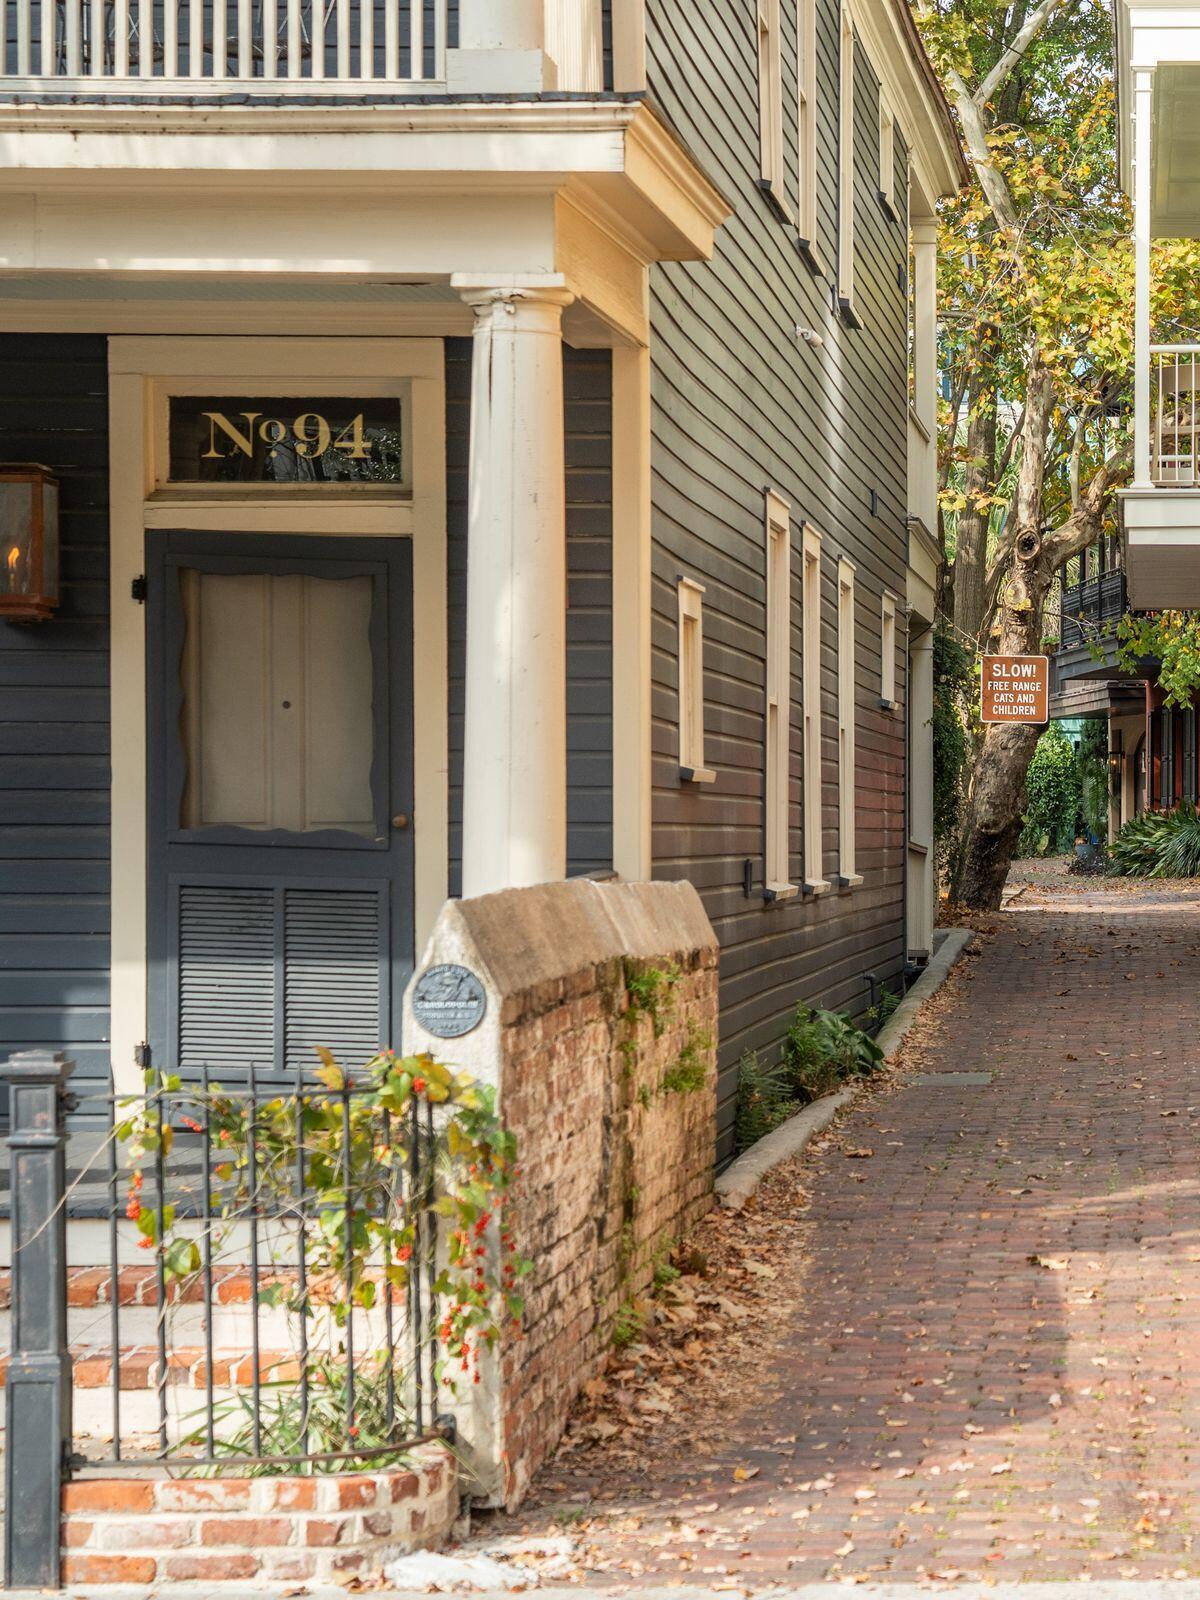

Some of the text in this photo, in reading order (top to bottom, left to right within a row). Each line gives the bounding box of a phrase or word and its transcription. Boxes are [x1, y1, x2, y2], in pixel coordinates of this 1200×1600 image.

[992, 664, 1036, 677] SLOW!
[987, 681, 1041, 691] FREE RANGE
[994, 693, 1034, 703] CATS AND
[992, 705, 1036, 715] CHILDREN
